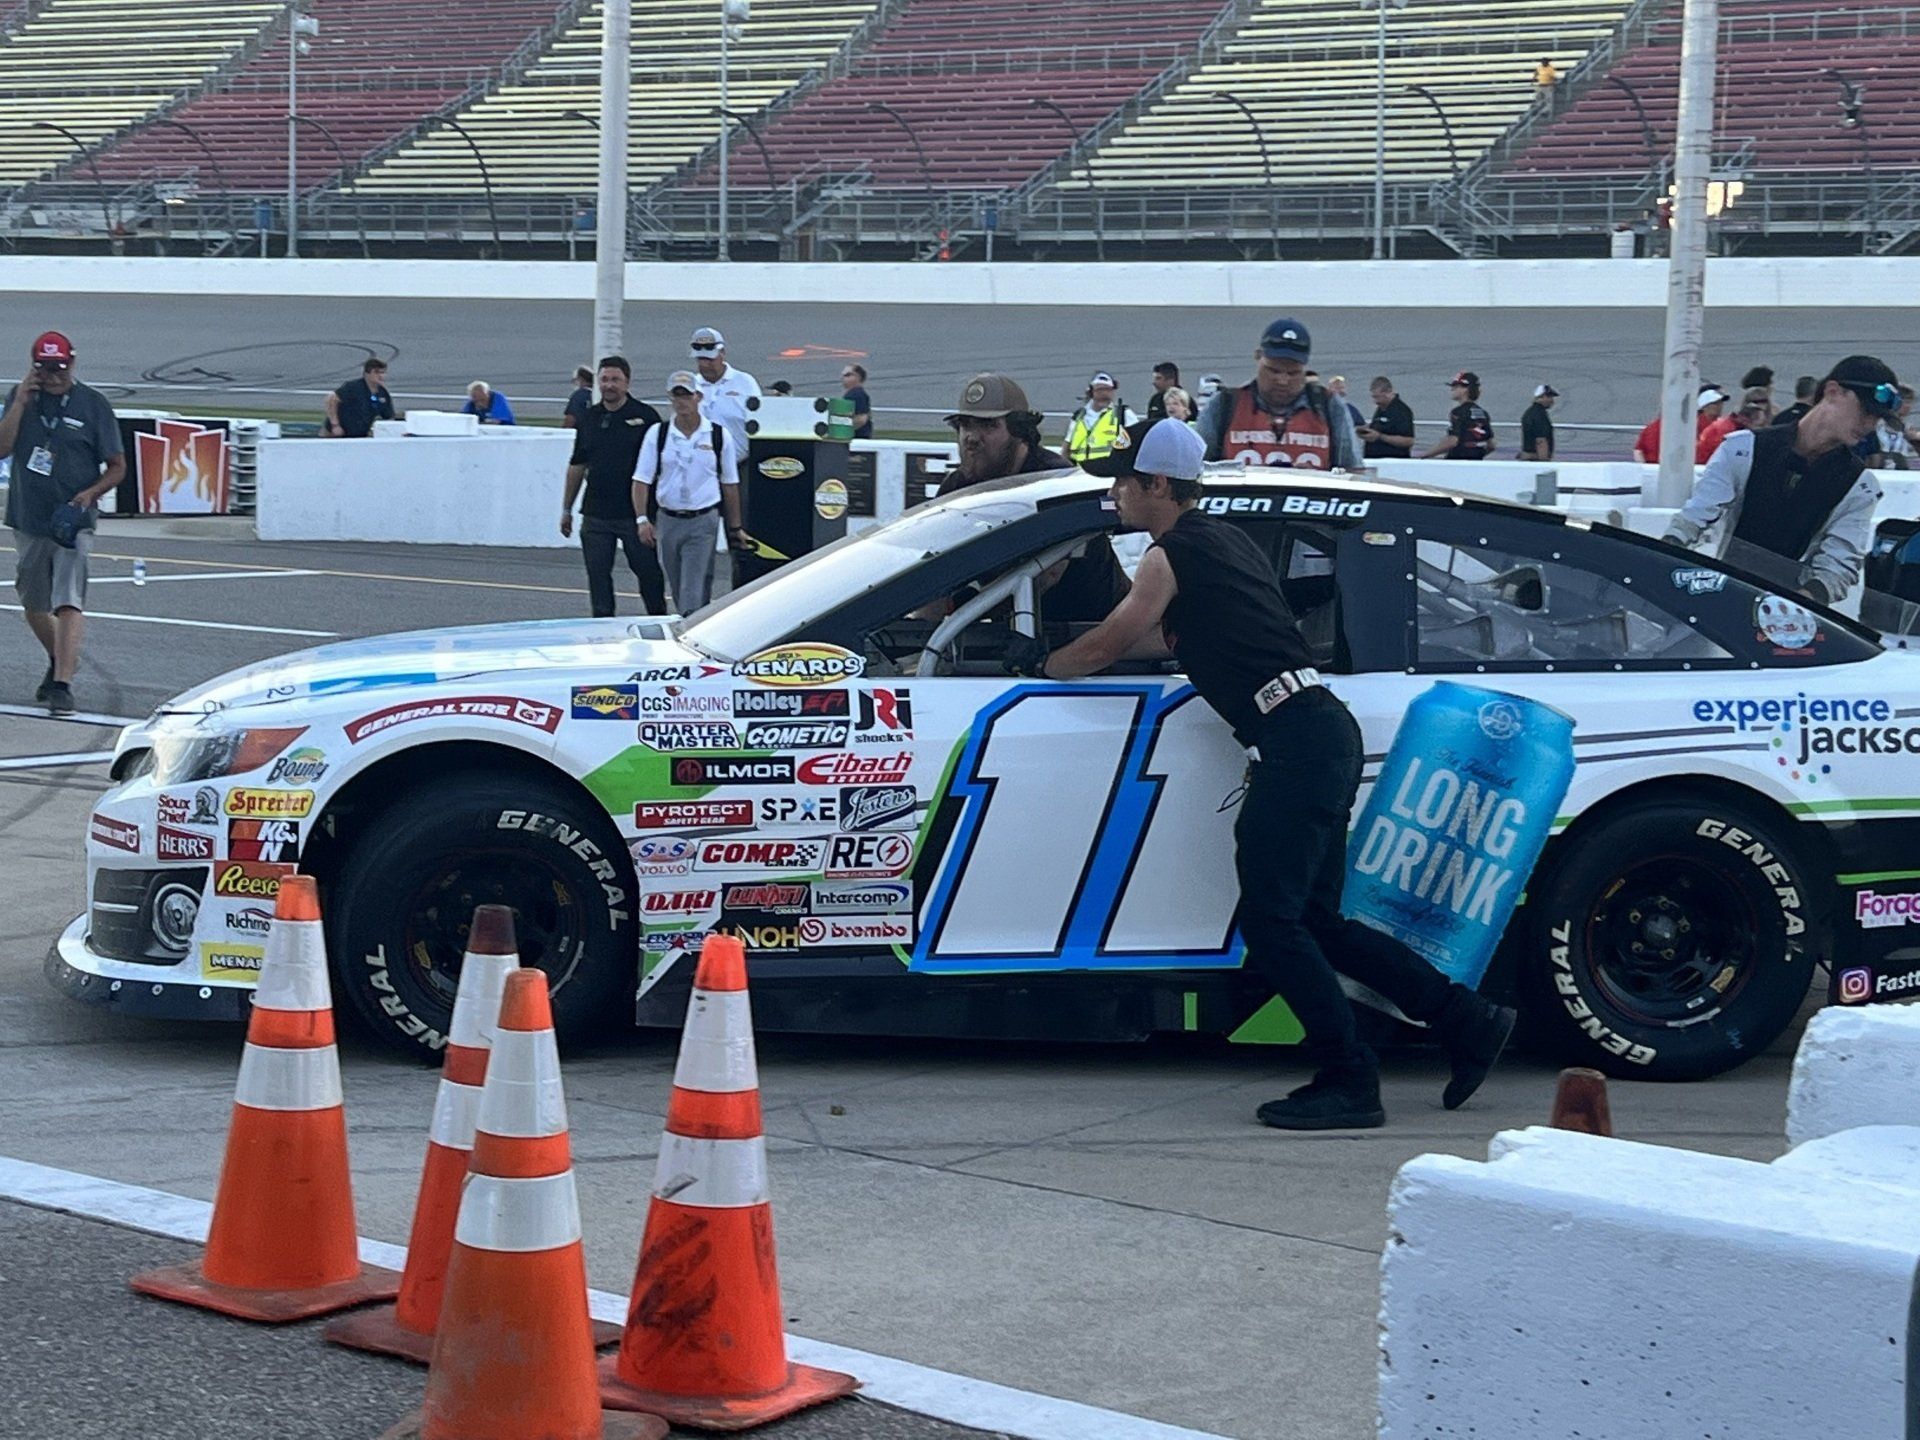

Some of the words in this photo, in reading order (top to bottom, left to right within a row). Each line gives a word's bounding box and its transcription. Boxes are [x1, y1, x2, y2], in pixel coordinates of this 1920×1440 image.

[1281, 495, 1371, 518] Baird
[627, 666, 691, 682] ARCA
[732, 657, 862, 677] MENARDS
[576, 694, 635, 707] SUNOCO
[734, 691, 802, 715] Holley
[356, 704, 458, 738] GENERAL
[459, 702, 512, 716] TIRE
[1693, 692, 1890, 731] experience
[641, 724, 730, 742] QUARTER
[658, 736, 735, 749] MASTER
[855, 732, 903, 743] shocks
[1797, 716, 1920, 765] jackso
[266, 756, 329, 784] Bounty
[706, 764, 791, 778] ILMOR
[797, 751, 912, 785] Eibach
[158, 794, 191, 809] Sioux
[230, 790, 310, 814] Sprecher
[642, 804, 746, 818] PYROTECT
[1390, 757, 1525, 860] LONG
[158, 808, 187, 823] Chief
[702, 843, 796, 864] COMP
[765, 858, 809, 867] CAMS
[497, 810, 629, 931] GENERAL
[640, 865, 687, 875] VOLVO
[1354, 814, 1513, 926] DRINK
[816, 891, 898, 906] Intercomp
[722, 925, 800, 948] NOH
[831, 921, 907, 938] brembo
[1550, 920, 1657, 1065] GENERAL
